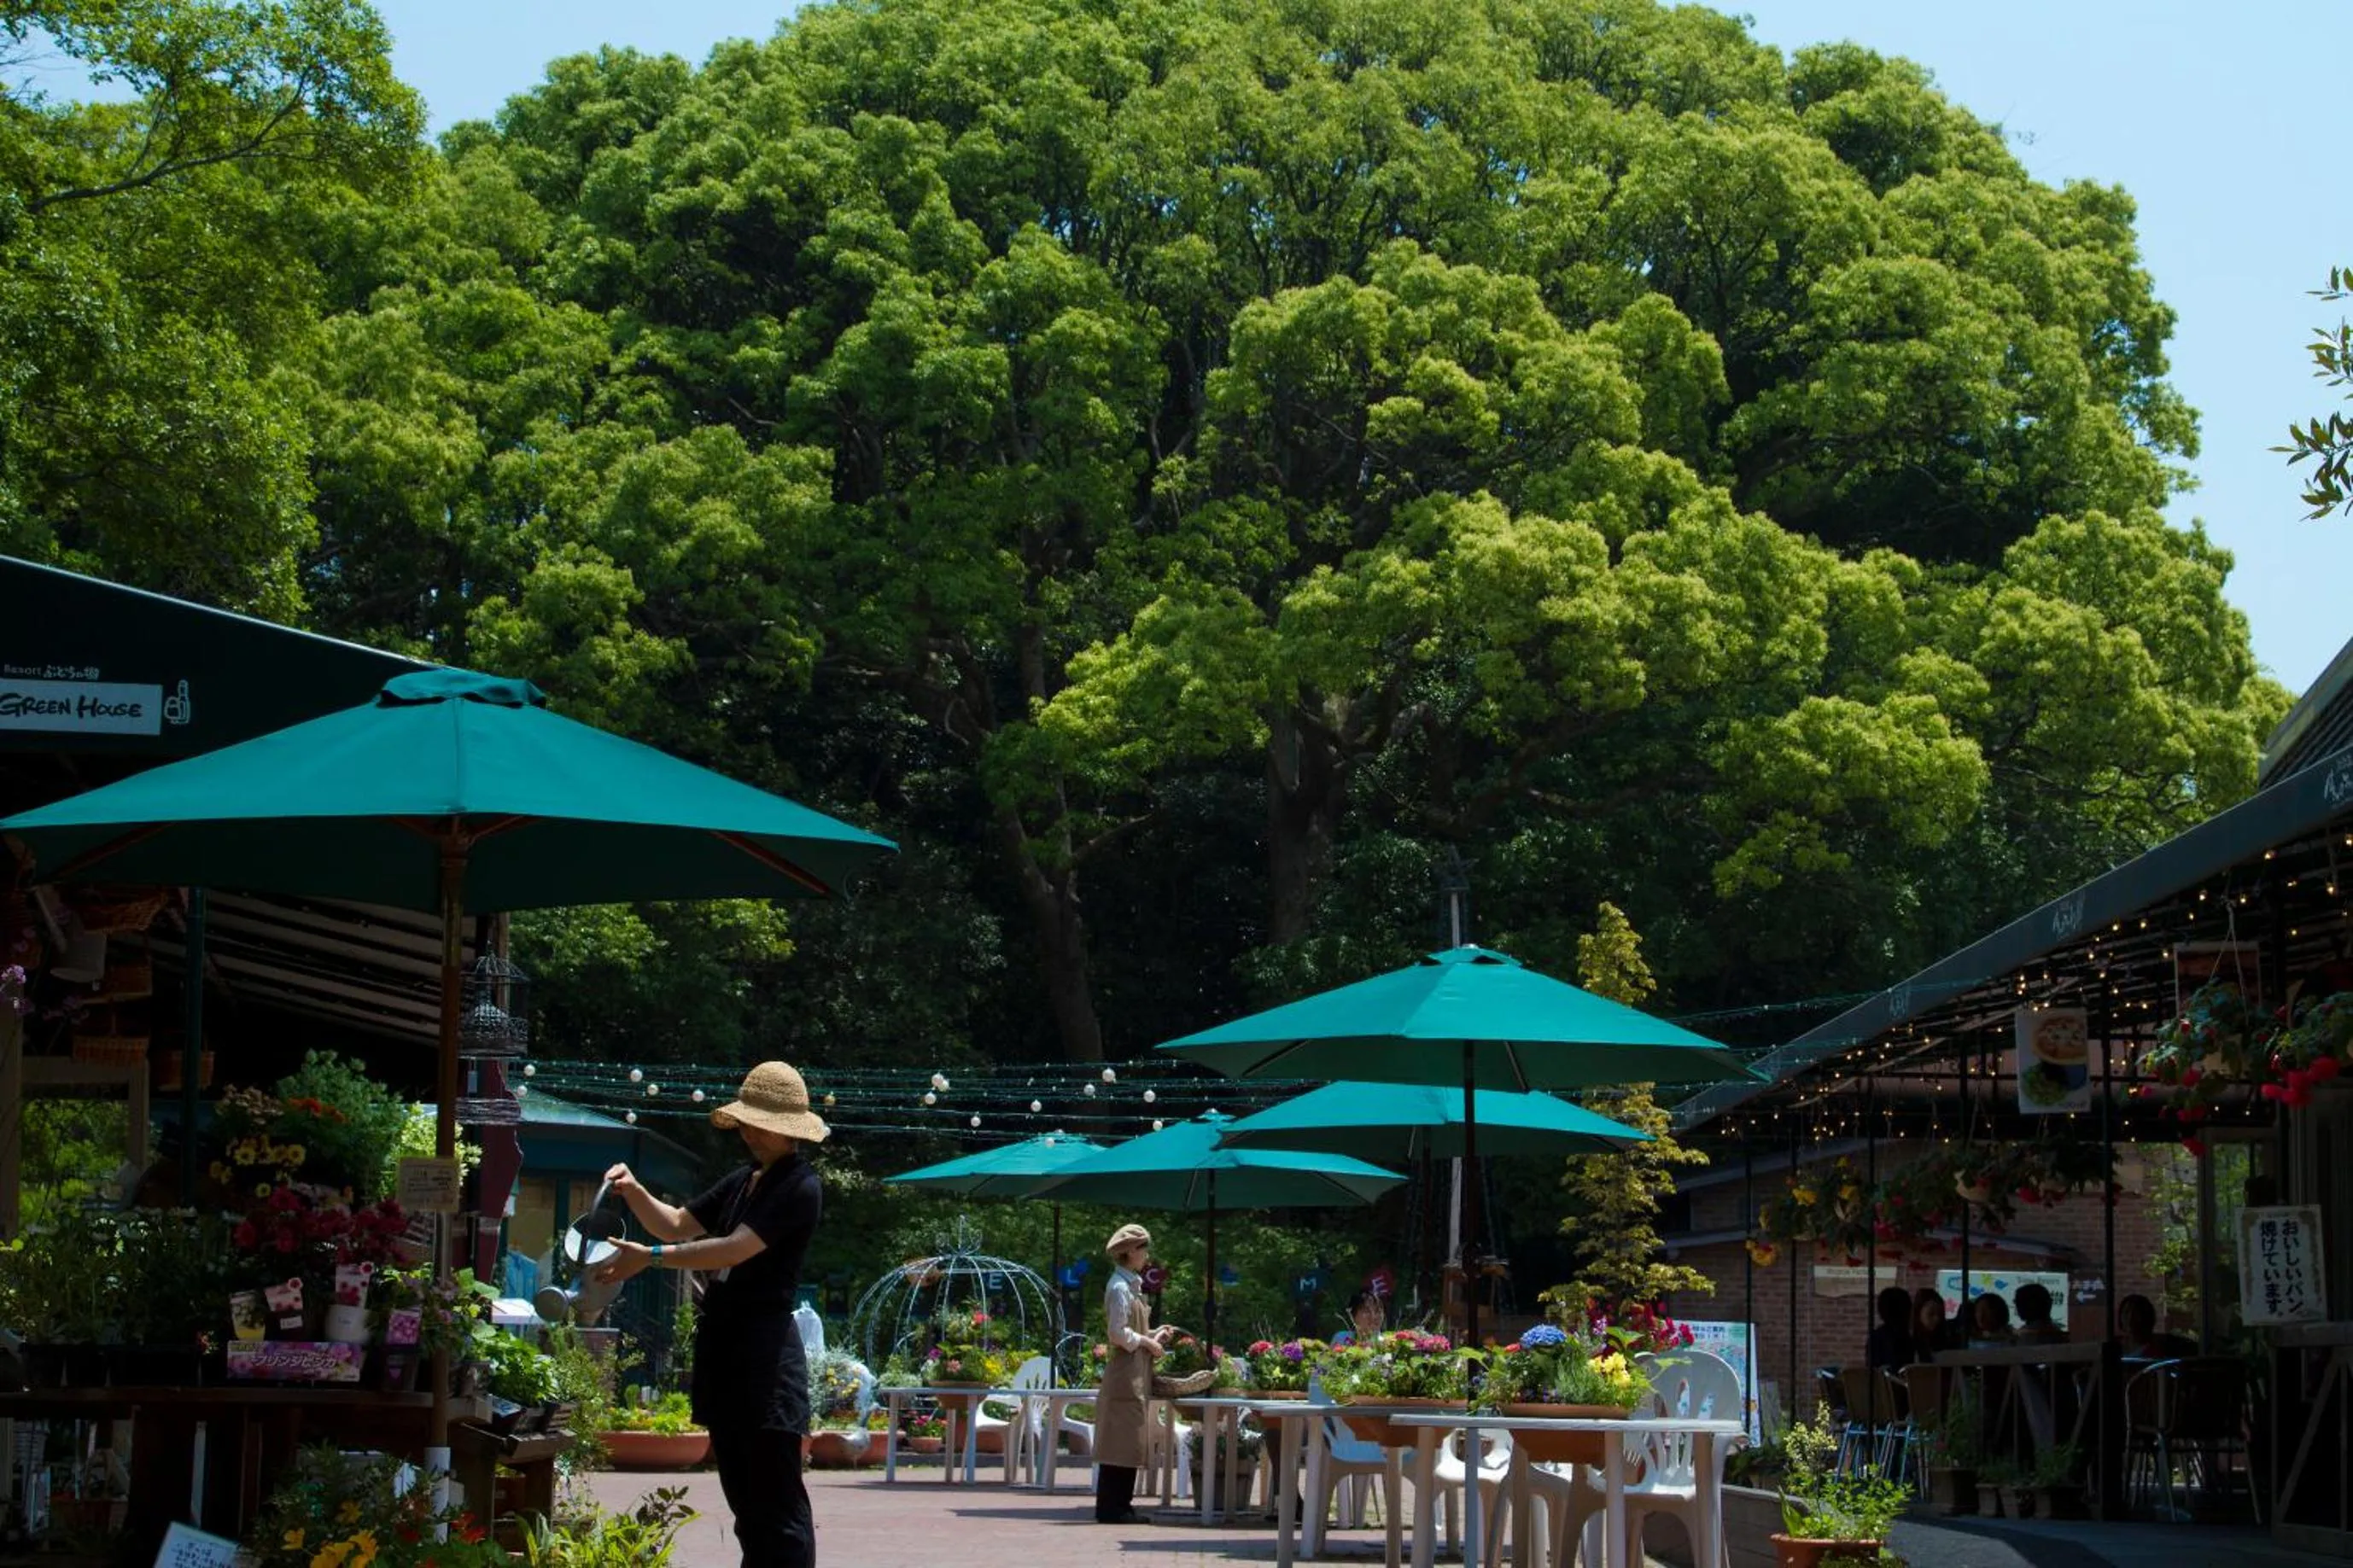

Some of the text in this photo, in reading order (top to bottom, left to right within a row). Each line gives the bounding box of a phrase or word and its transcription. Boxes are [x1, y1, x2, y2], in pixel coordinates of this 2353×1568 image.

[2283, 1220, 2303, 1312] おいしいパン
